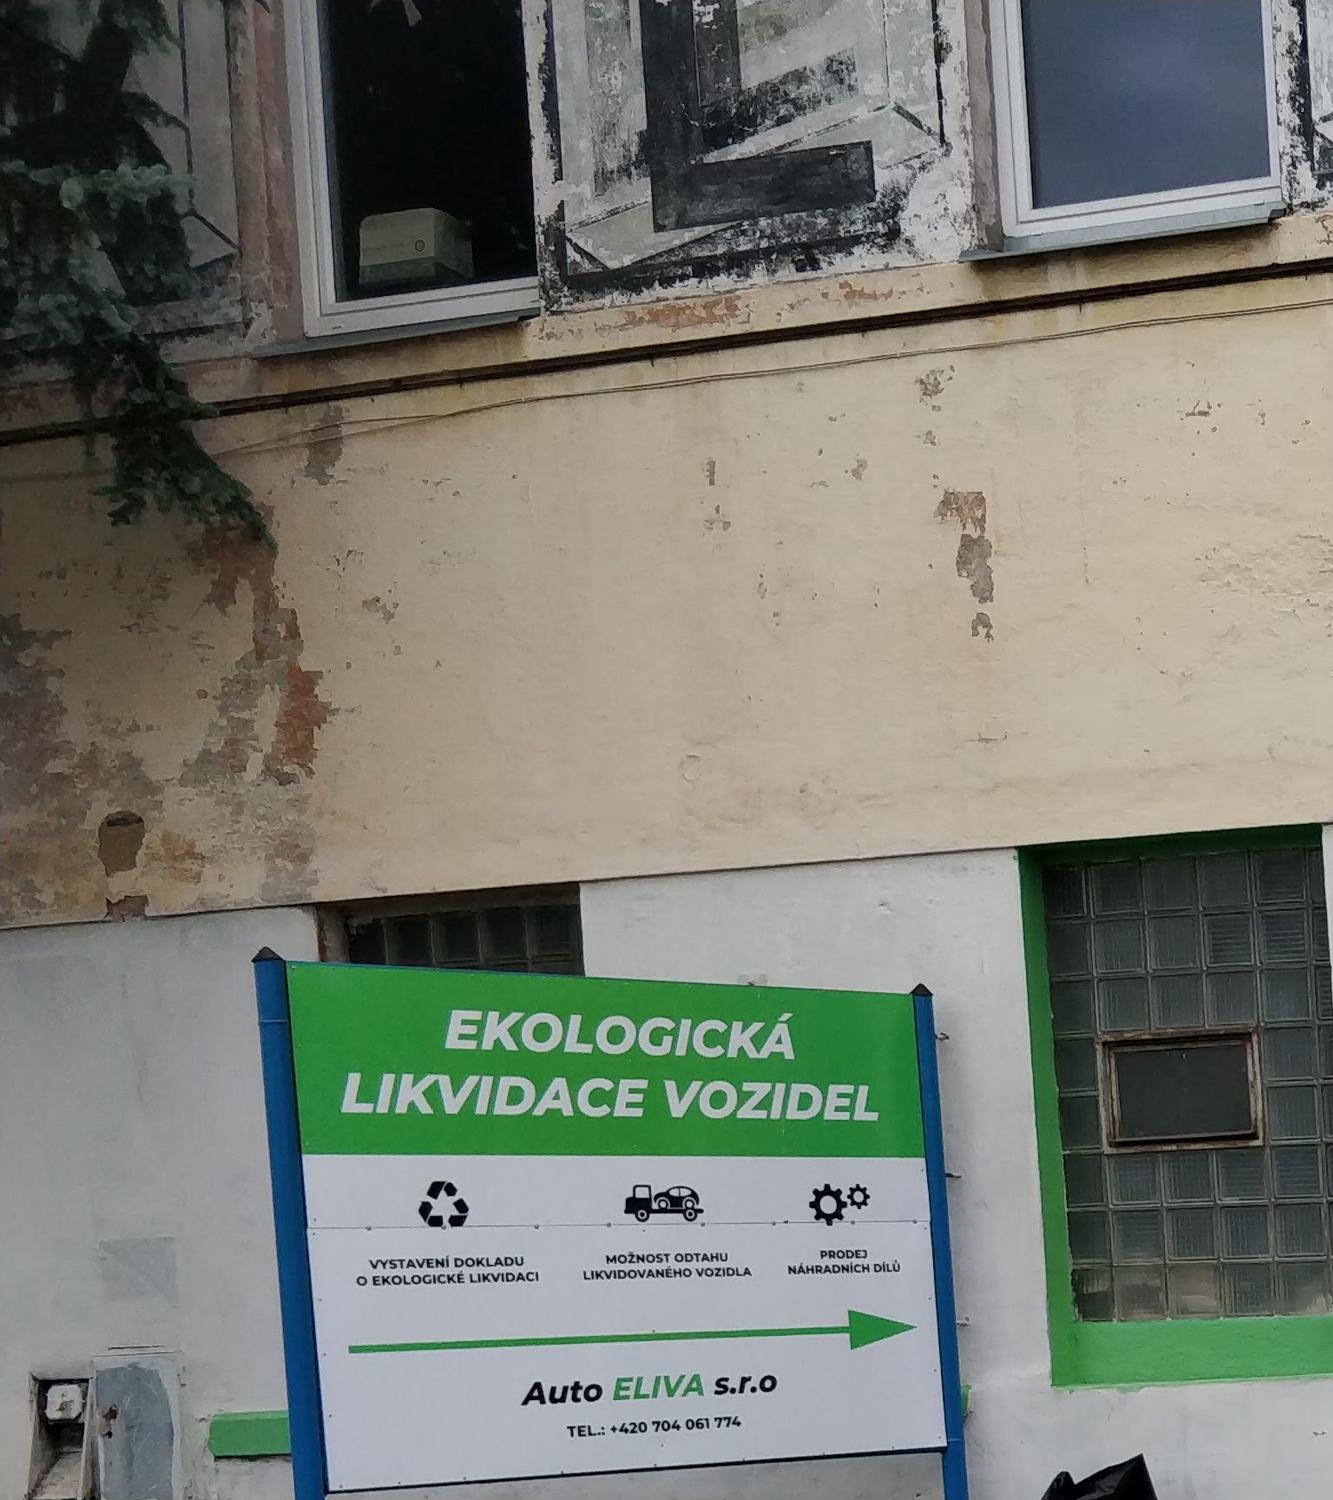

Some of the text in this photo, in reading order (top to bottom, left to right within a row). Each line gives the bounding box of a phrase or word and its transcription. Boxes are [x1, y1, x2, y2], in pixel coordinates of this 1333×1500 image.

[445, 1009, 796, 1059] EKOLOGICKÁ
[341, 1072, 879, 1121] LIKVIDACE VOZIDEL
[369, 1254, 525, 1270] VYSTAVENÍ DOKLADU
[606, 1251, 729, 1265] MOŽNOST ODTAHU
[820, 1249, 868, 1260] PRODEJ
[583, 1265, 753, 1281] LIKVIDOVANÉHO VOZIDLA
[788, 1259, 901, 1275] NÁHRADNÍCH DÍLŮ
[356, 1270, 540, 1287] O EKOLOGICKÉ LIKVIDACI
[521, 1374, 778, 1406] Auto ELIVA s.r.o
[567, 1416, 742, 1438] TEL.: +420 704 061 774
